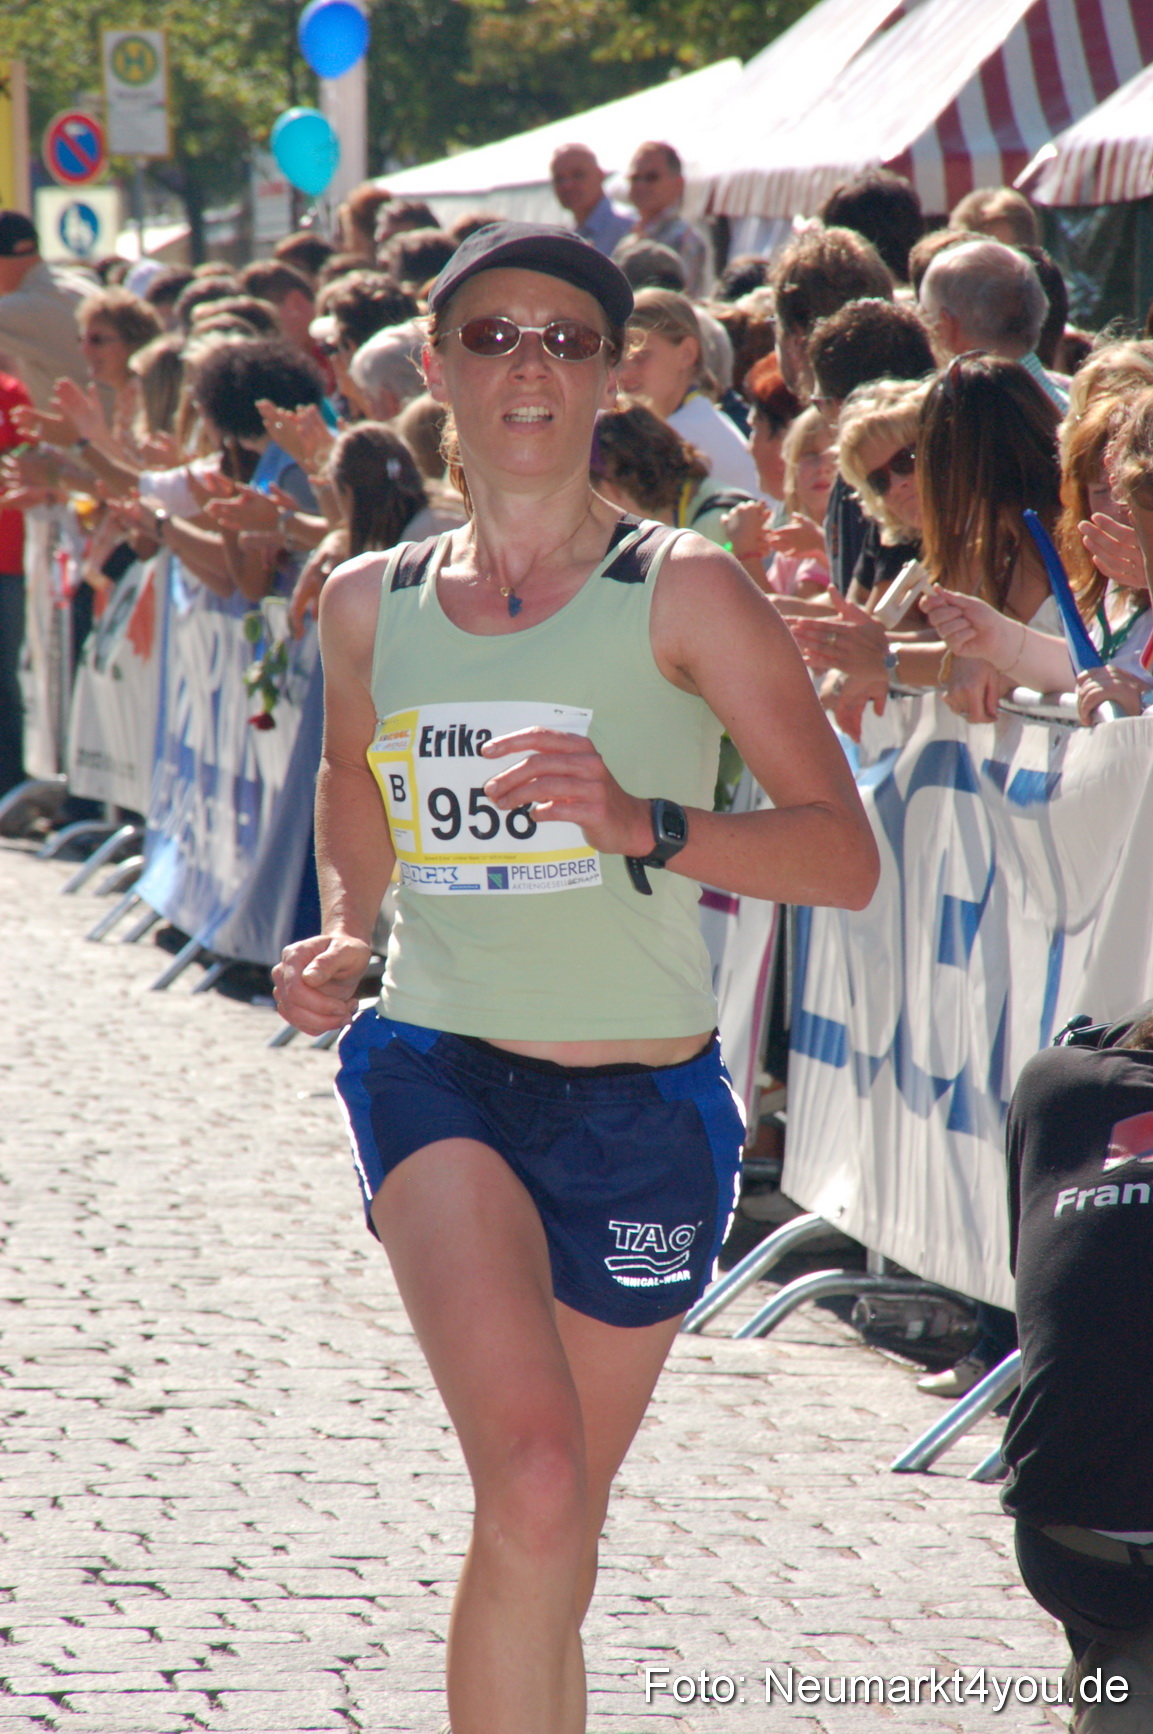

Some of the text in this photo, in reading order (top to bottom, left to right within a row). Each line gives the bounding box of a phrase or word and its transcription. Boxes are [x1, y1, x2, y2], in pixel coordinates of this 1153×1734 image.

[419, 724, 492, 757] Erika
[389, 774, 406, 802] B
[428, 787, 537, 840] 958
[511, 858, 596, 880] PFLEIDERER
[1054, 1182, 1151, 1217] Fran
[609, 1220, 696, 1252] TAO
